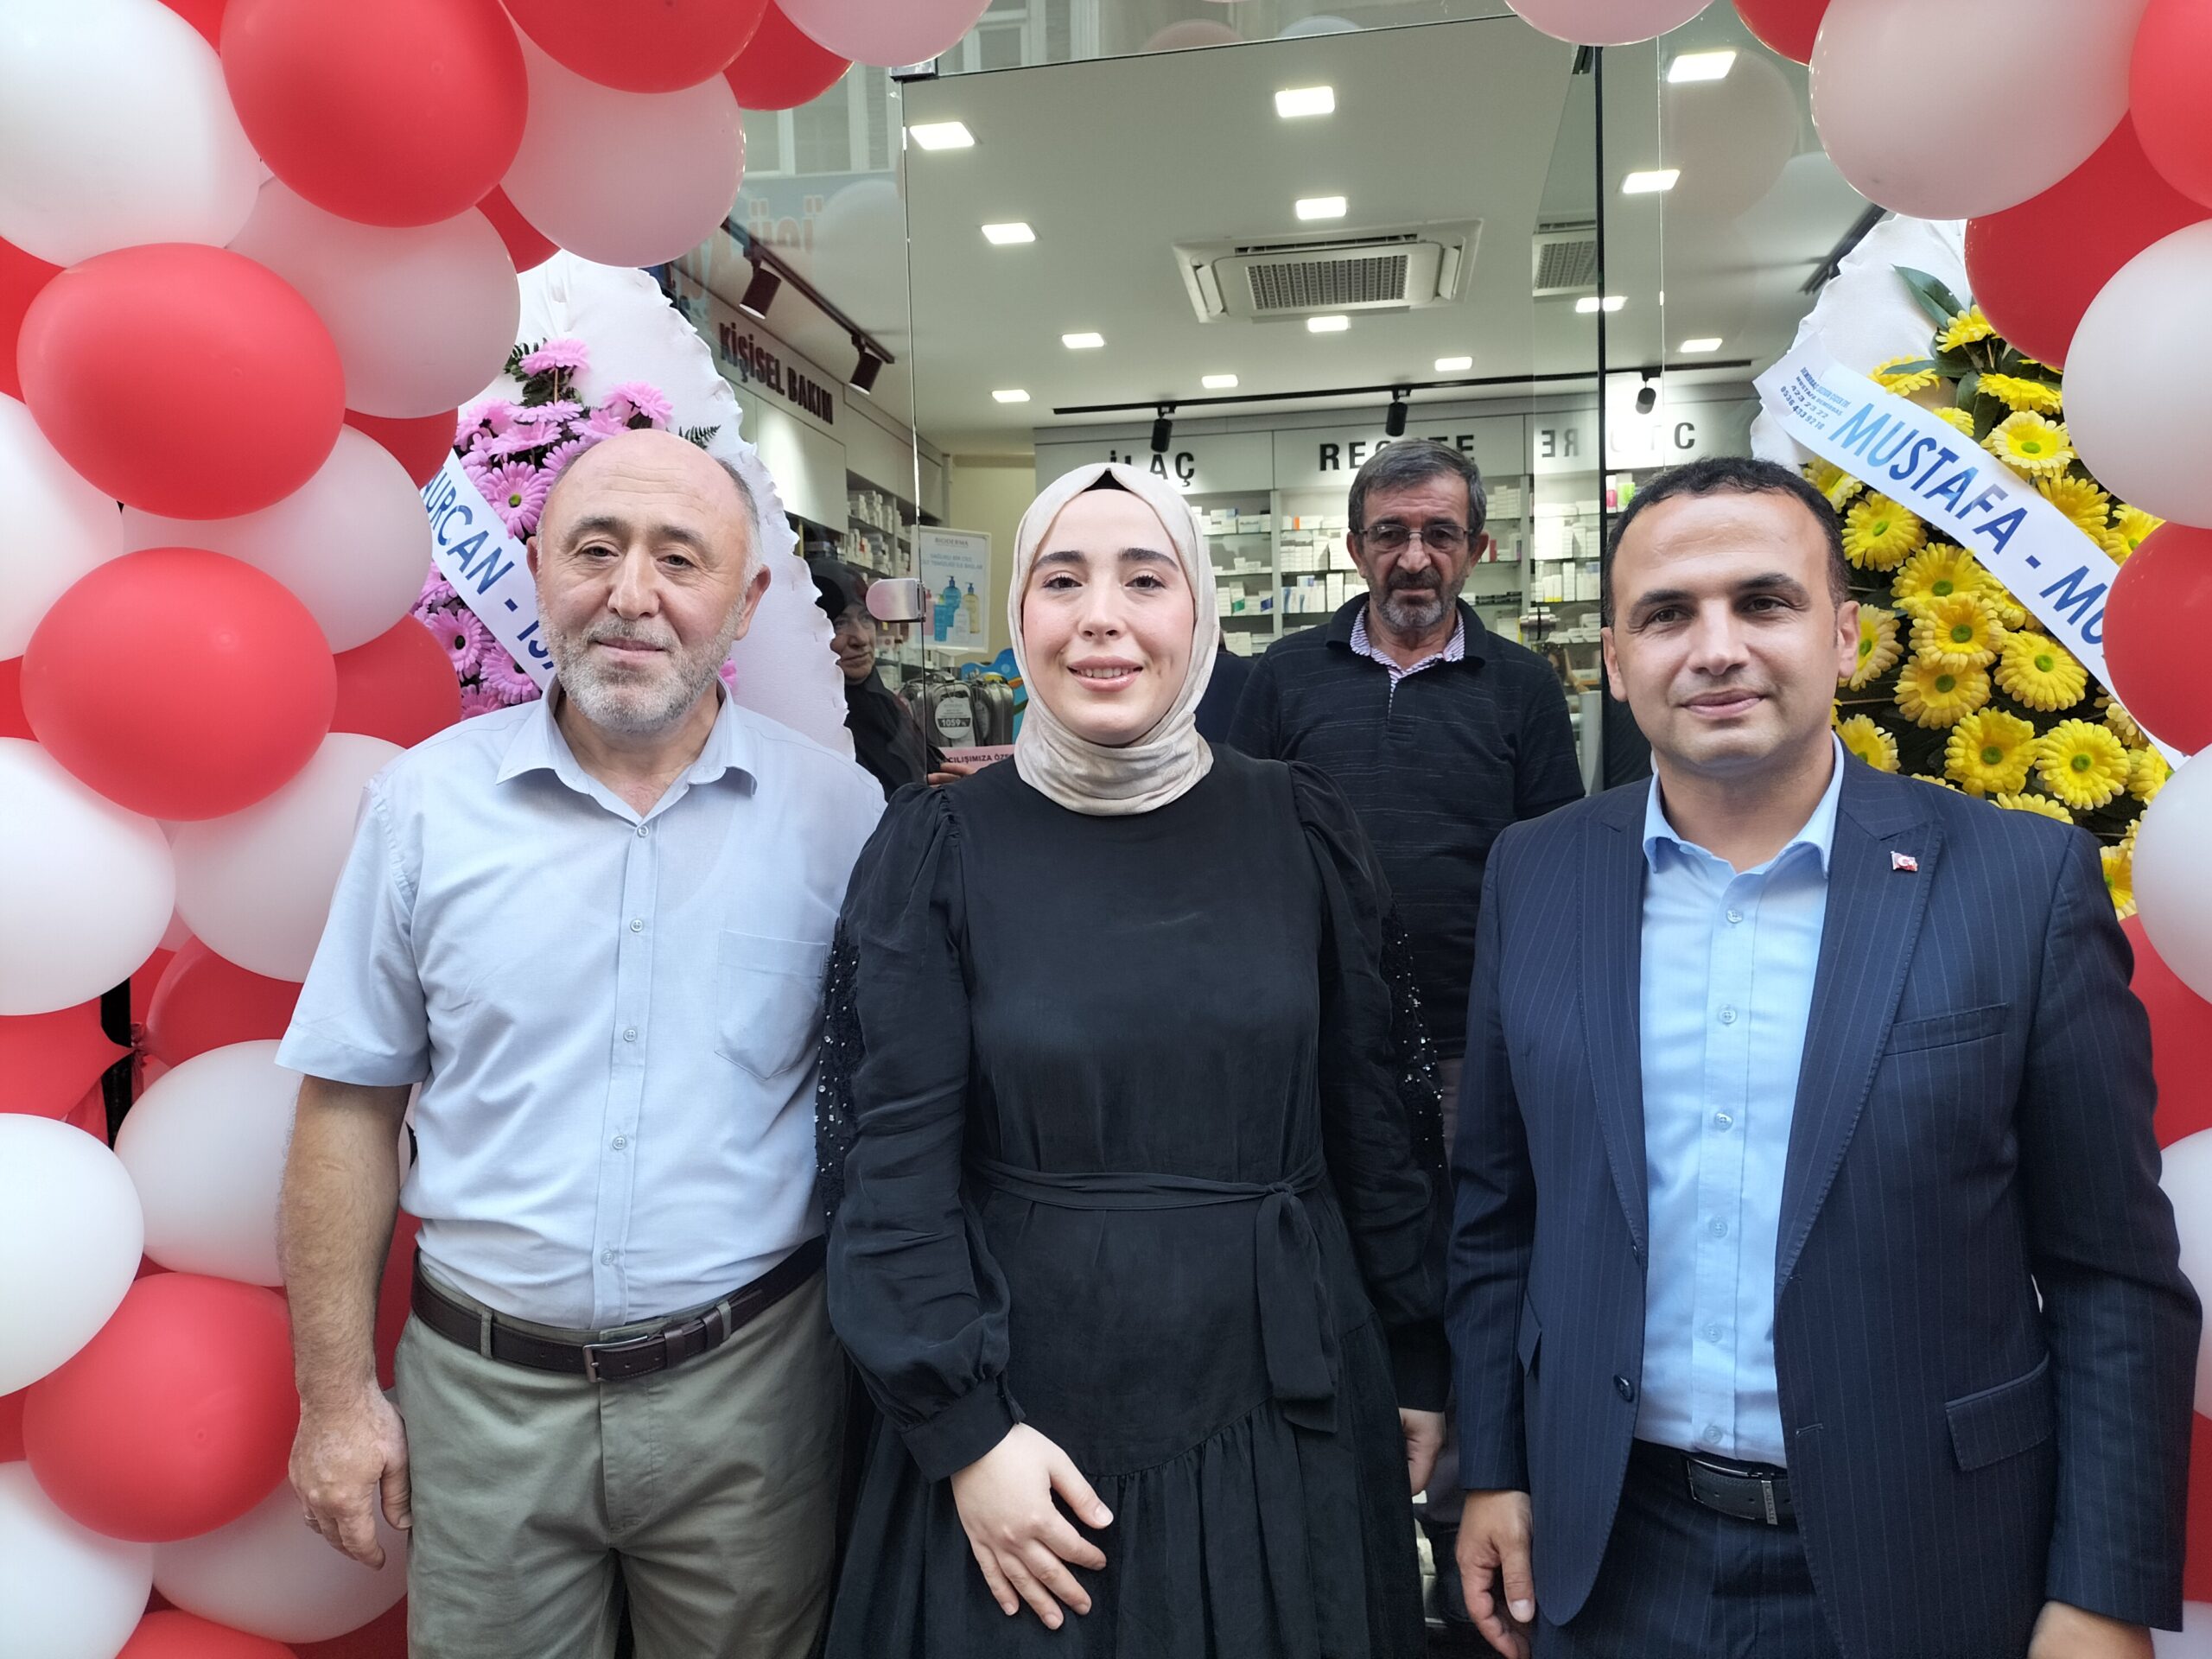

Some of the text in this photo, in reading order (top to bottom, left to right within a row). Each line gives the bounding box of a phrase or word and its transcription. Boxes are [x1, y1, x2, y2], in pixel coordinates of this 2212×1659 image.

[719, 322, 834, 425] KİŞİSEL BAKIM
[1828, 403, 2029, 555] MUSTAFA
[2039, 565, 2108, 645] MU
